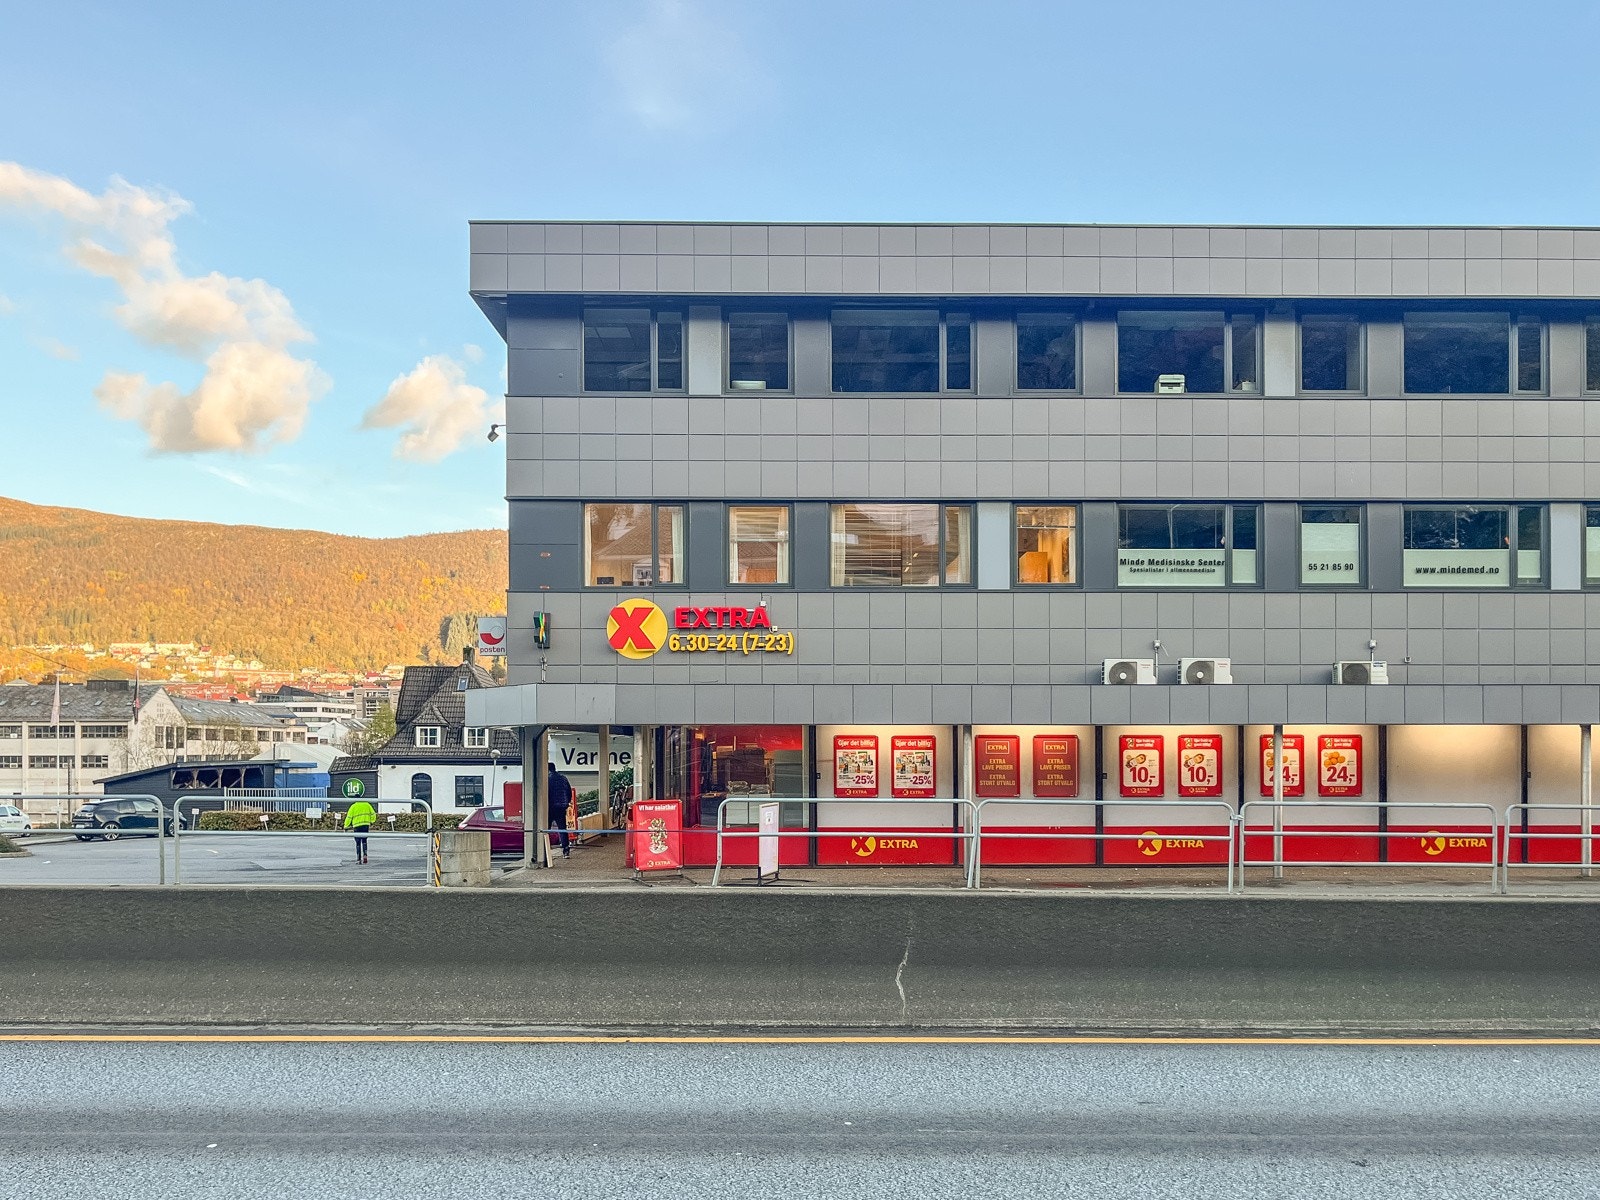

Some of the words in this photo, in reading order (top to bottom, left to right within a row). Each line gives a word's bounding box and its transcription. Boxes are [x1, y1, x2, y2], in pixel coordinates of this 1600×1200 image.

[1119, 558, 1145, 566] Minde
[1147, 558, 1195, 566] Medisinske
[1198, 558, 1225, 566] Senter
[1308, 563, 1318, 571] 55
[1320, 563, 1329, 571] 21
[1332, 563, 1342, 571] 85
[1344, 563, 1354, 571] 90
[1415, 565, 1500, 574] www.mindemed.no
[674, 606, 771, 629] EXTRA
[668, 633, 738, 652] 6.30-24
[742, 631, 795, 655] (7-23)
[480, 646, 505, 654] posten
[852, 775, 875, 785] -25%
[909, 775, 932, 785] -25%
[1129, 766, 1156, 785] 10,-
[1187, 766, 1214, 785] 10,-
[1326, 766, 1355, 784] 24,-
[879, 839, 919, 849] EXTRA
[1166, 838, 1205, 848] EXTRA
[1449, 838, 1487, 847] EXTRA
